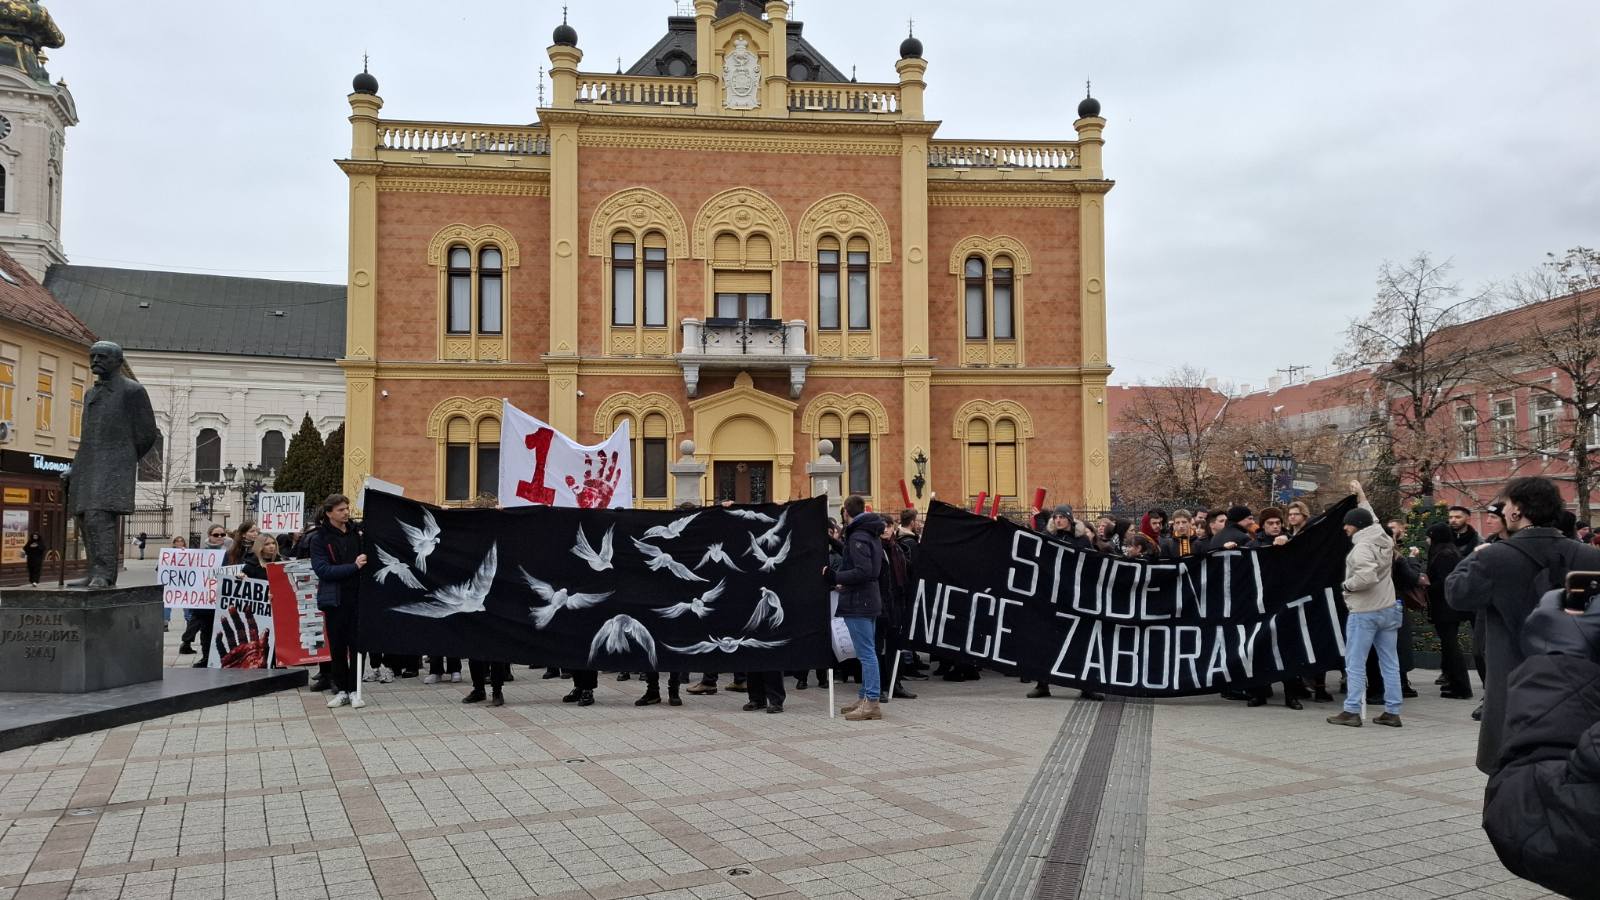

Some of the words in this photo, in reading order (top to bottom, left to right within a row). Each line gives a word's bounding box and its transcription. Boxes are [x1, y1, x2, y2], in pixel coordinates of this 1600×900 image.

[516, 427, 556, 507] 1
[262, 496, 301, 513] СТУДЕНТИ
[262, 513, 272, 529] НЕ
[160, 569, 197, 588] CRNO
[1007, 530, 1266, 620] STUDENTI
[908, 578, 1024, 667] NEĆE
[1050, 586, 1346, 691] ZABORAVITI
